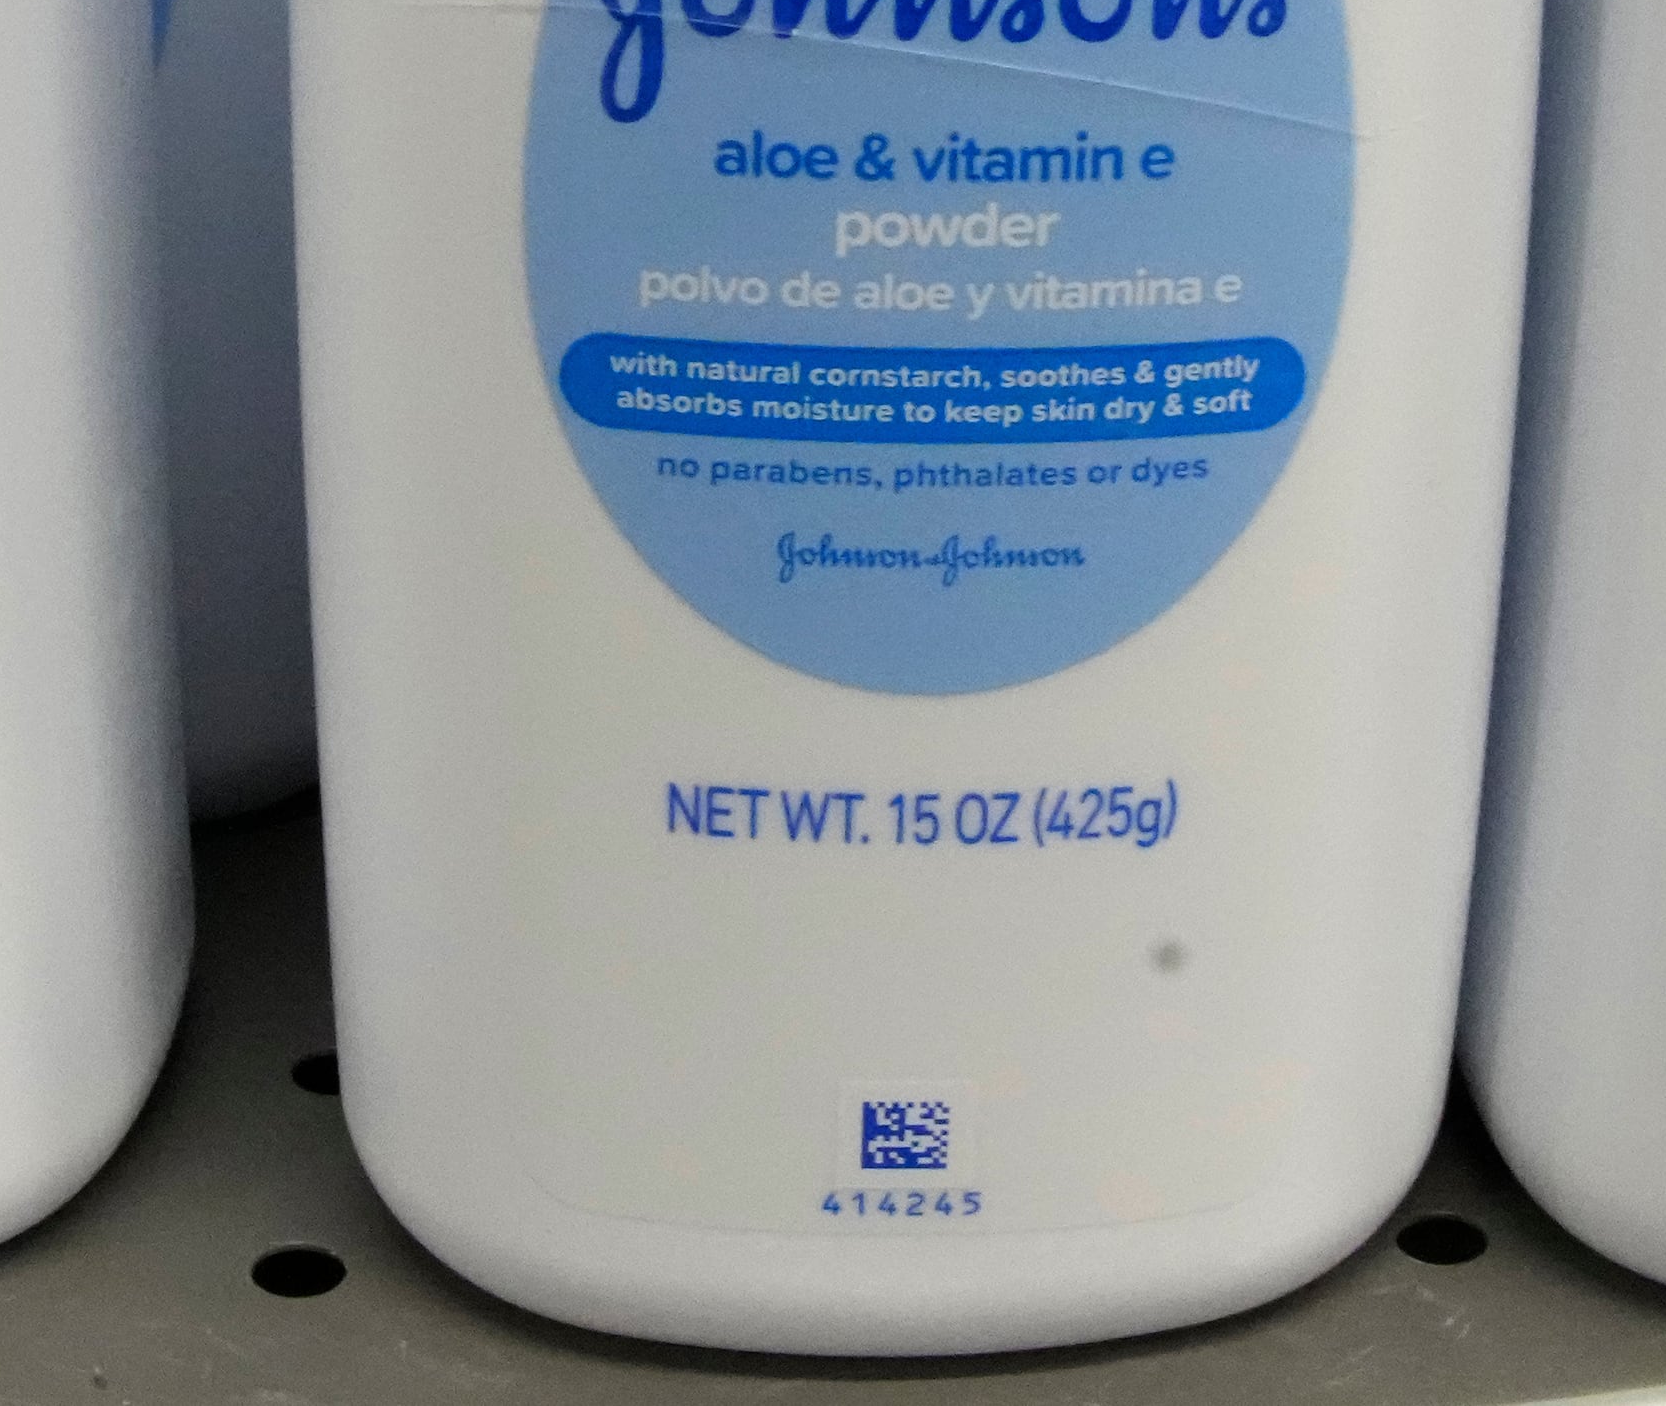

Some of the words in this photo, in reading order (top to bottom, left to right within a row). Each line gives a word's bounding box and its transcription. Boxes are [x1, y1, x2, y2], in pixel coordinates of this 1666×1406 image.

[714, 130, 839, 181] aloe
[855, 133, 895, 181] &
[912, 132, 1124, 182] vitamin
[1141, 145, 1175, 180] e
[835, 202, 1060, 257] powder
[638, 264, 767, 307] polvo
[782, 271, 840, 309] de
[855, 273, 953, 311] aloe
[967, 281, 992, 320] y
[1007, 268, 1199, 311] vitamina
[1213, 274, 1242, 304] e
[609, 350, 677, 380] with
[687, 355, 799, 385] natural
[1001, 359, 1125, 387] soothes
[1164, 353, 1259, 387] gently
[616, 388, 742, 417] absorbs
[752, 395, 894, 423] moisture
[903, 400, 934, 423] to
[944, 398, 1022, 429] keep
[1031, 398, 1094, 423] skin
[1104, 395, 1154, 425] dry
[1194, 388, 1252, 415] soft
[657, 453, 699, 479] no
[894, 457, 1078, 492] phthalates
[1087, 460, 1122, 484] or
[1131, 456, 1208, 486] dyes
[667, 783, 770, 839] NET
[781, 790, 869, 844] WT.
[888, 792, 940, 845] 15
[955, 792, 1021, 845] OZ
[1034, 778, 1178, 847] (425g)
[821, 1192, 982, 1216] 414245
